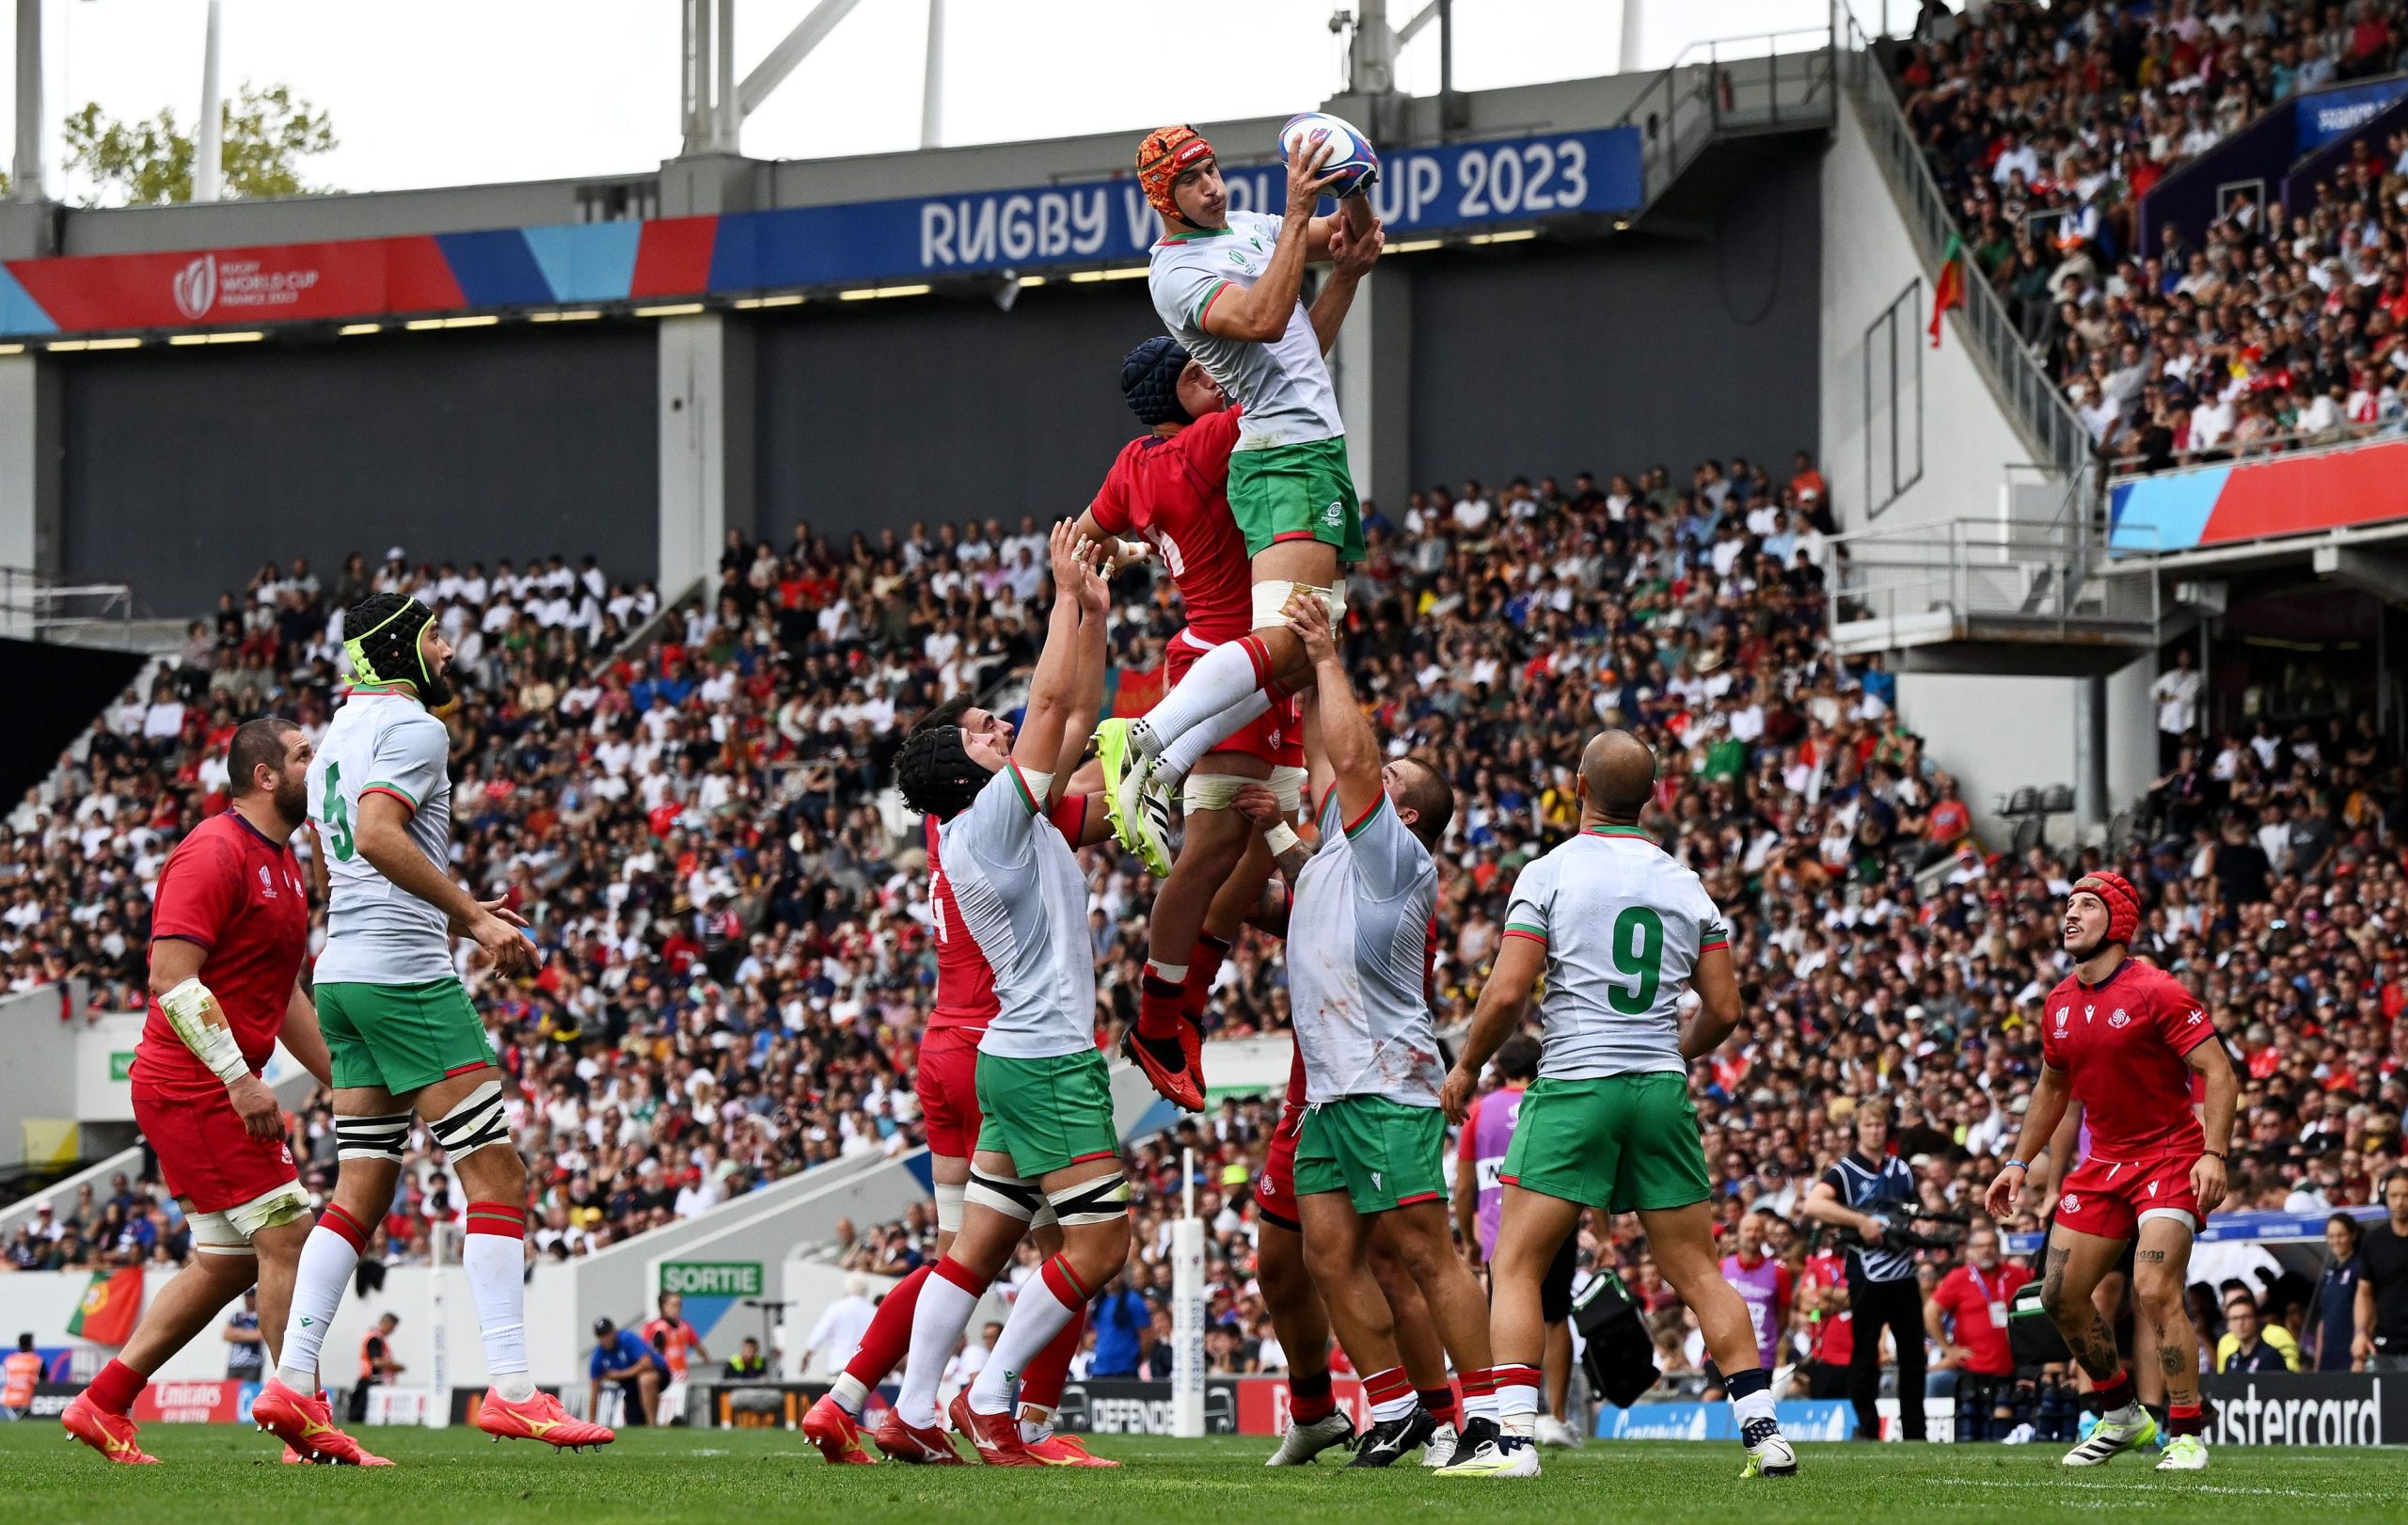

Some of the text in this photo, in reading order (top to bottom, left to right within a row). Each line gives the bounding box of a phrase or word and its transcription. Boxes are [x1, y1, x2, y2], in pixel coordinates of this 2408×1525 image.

[921, 186, 1108, 267] RUGBY
[1376, 156, 1443, 226] UP
[1459, 139, 1589, 217] 2023
[220, 270, 320, 292] WORLD CUP
[324, 761, 355, 862] 5
[928, 870, 948, 944] 4
[1608, 906, 1663, 1014] 9
[663, 1266, 757, 1293] SORTIE
[155, 1383, 221, 1408] Emirates
[1091, 1398, 1176, 1434] DEFENDE
[2203, 1377, 2382, 1446] astercard
